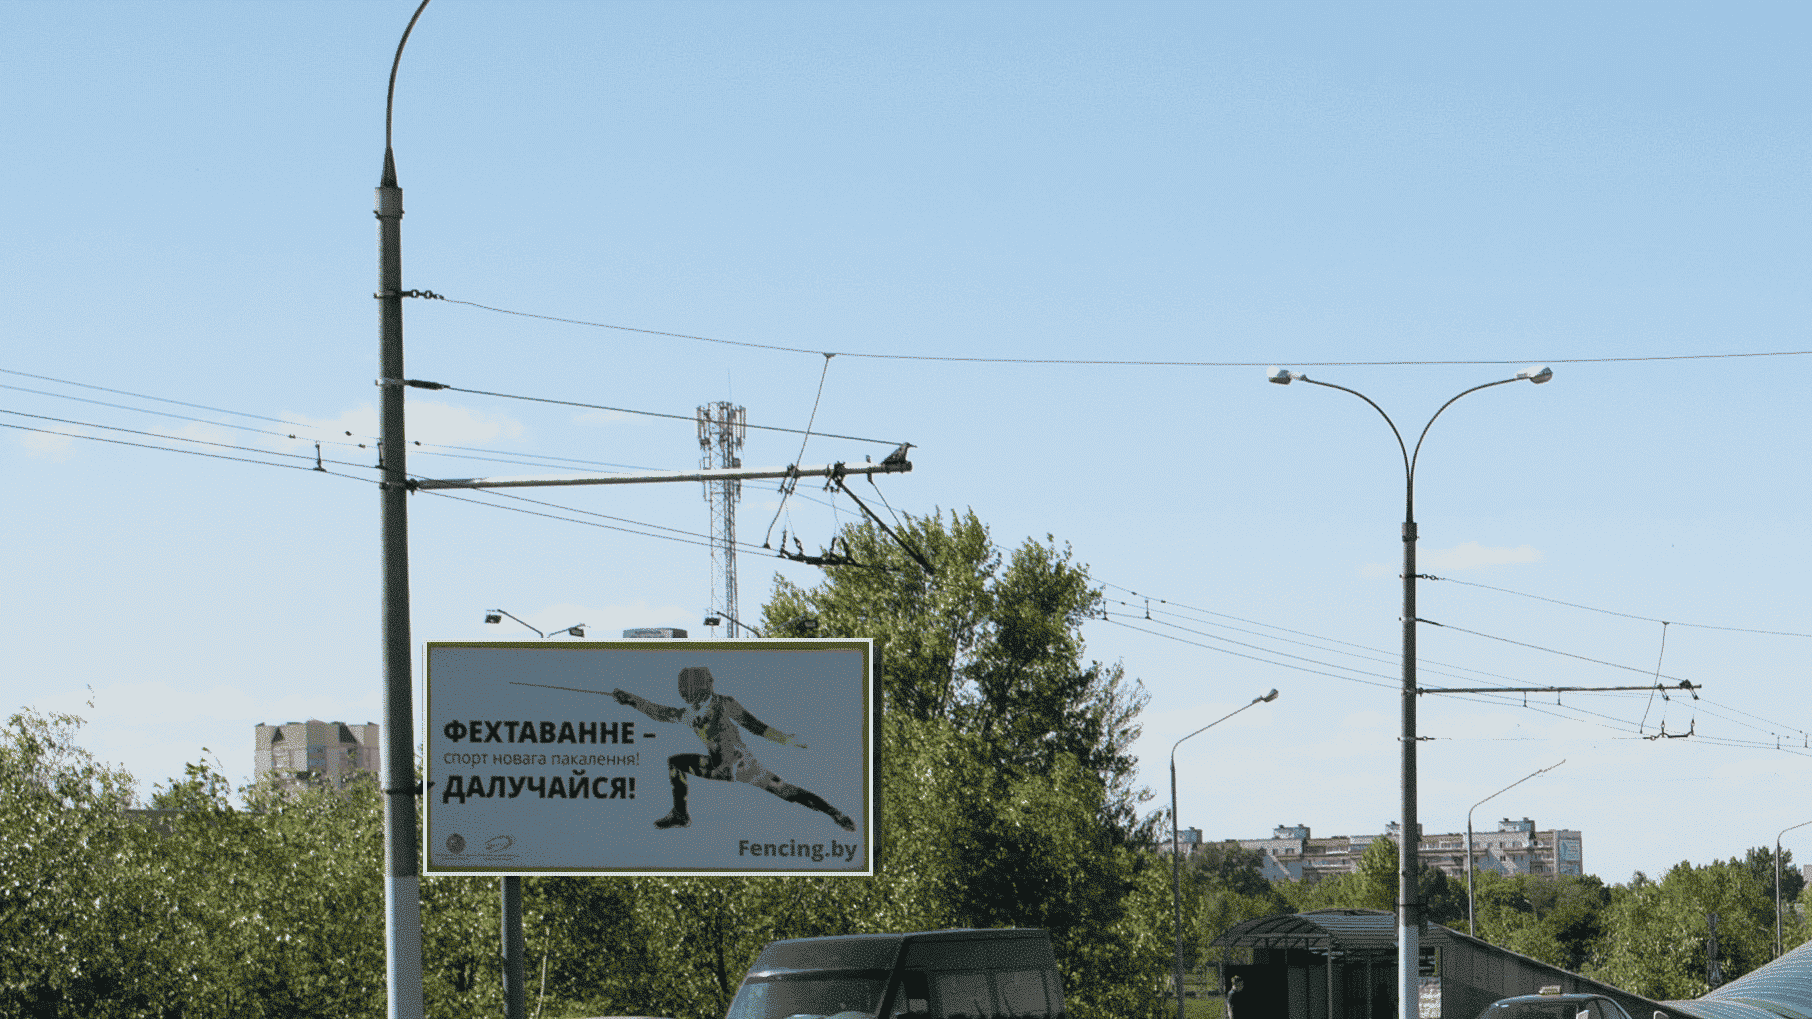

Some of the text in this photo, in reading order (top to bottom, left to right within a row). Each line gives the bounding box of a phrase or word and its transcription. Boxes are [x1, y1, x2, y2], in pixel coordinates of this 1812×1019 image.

[443, 719, 635, 744] ФЕХТАВАННЕ
[443, 751, 640, 769] спорт новага пакалення!
[442, 769, 636, 804] ДАЛУЧАЙСЯ!
[738, 838, 858, 862] Fencing.by
